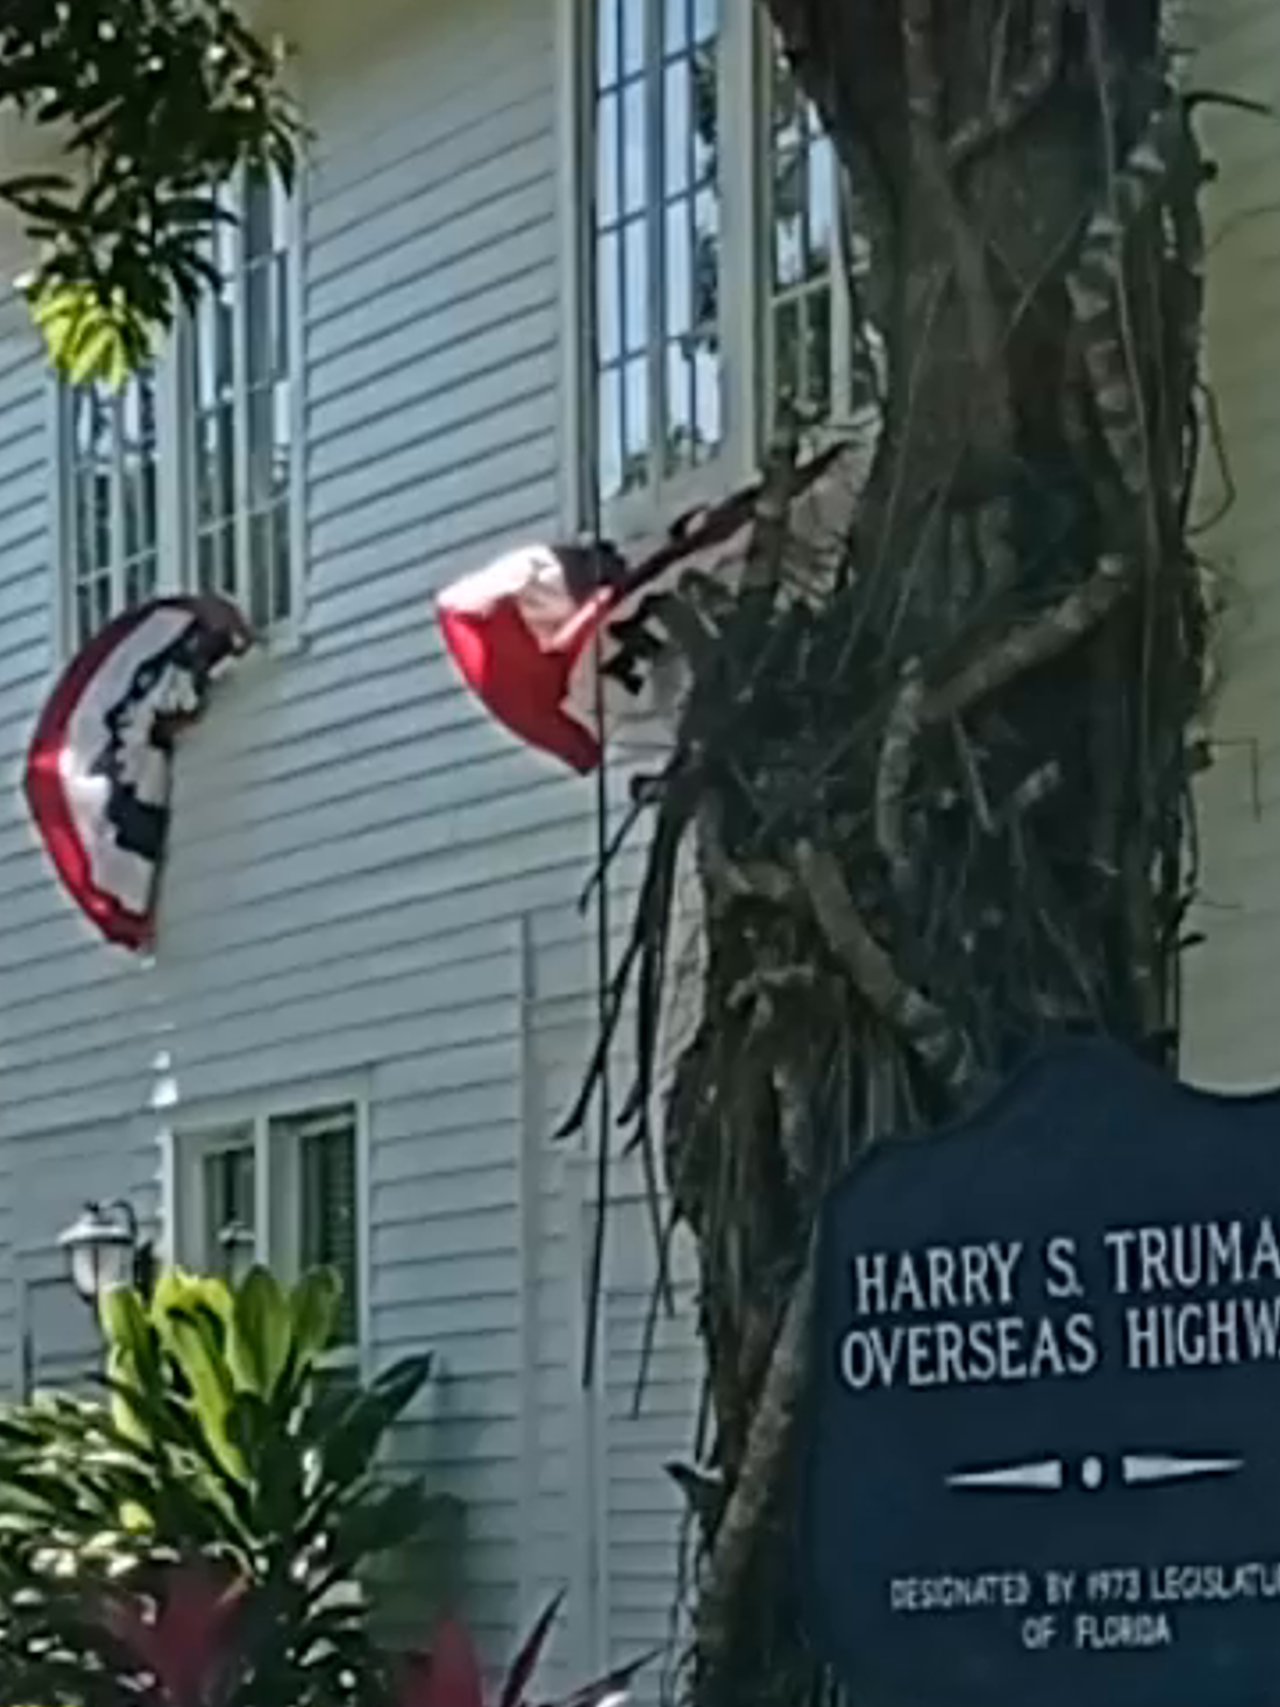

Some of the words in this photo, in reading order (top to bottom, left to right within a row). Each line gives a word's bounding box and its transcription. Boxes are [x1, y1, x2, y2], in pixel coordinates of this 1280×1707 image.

[855, 1241, 1023, 1315] HARRY
[1046, 1237, 1084, 1298] S.
[841, 1312, 1098, 1388] OVERSEAS
[890, 1575, 1031, 1612] DESIGNATED
[1045, 1569, 1076, 1605] BY
[1022, 1614, 1057, 1649] OF
[1076, 1612, 1172, 1649] FLORIDA
